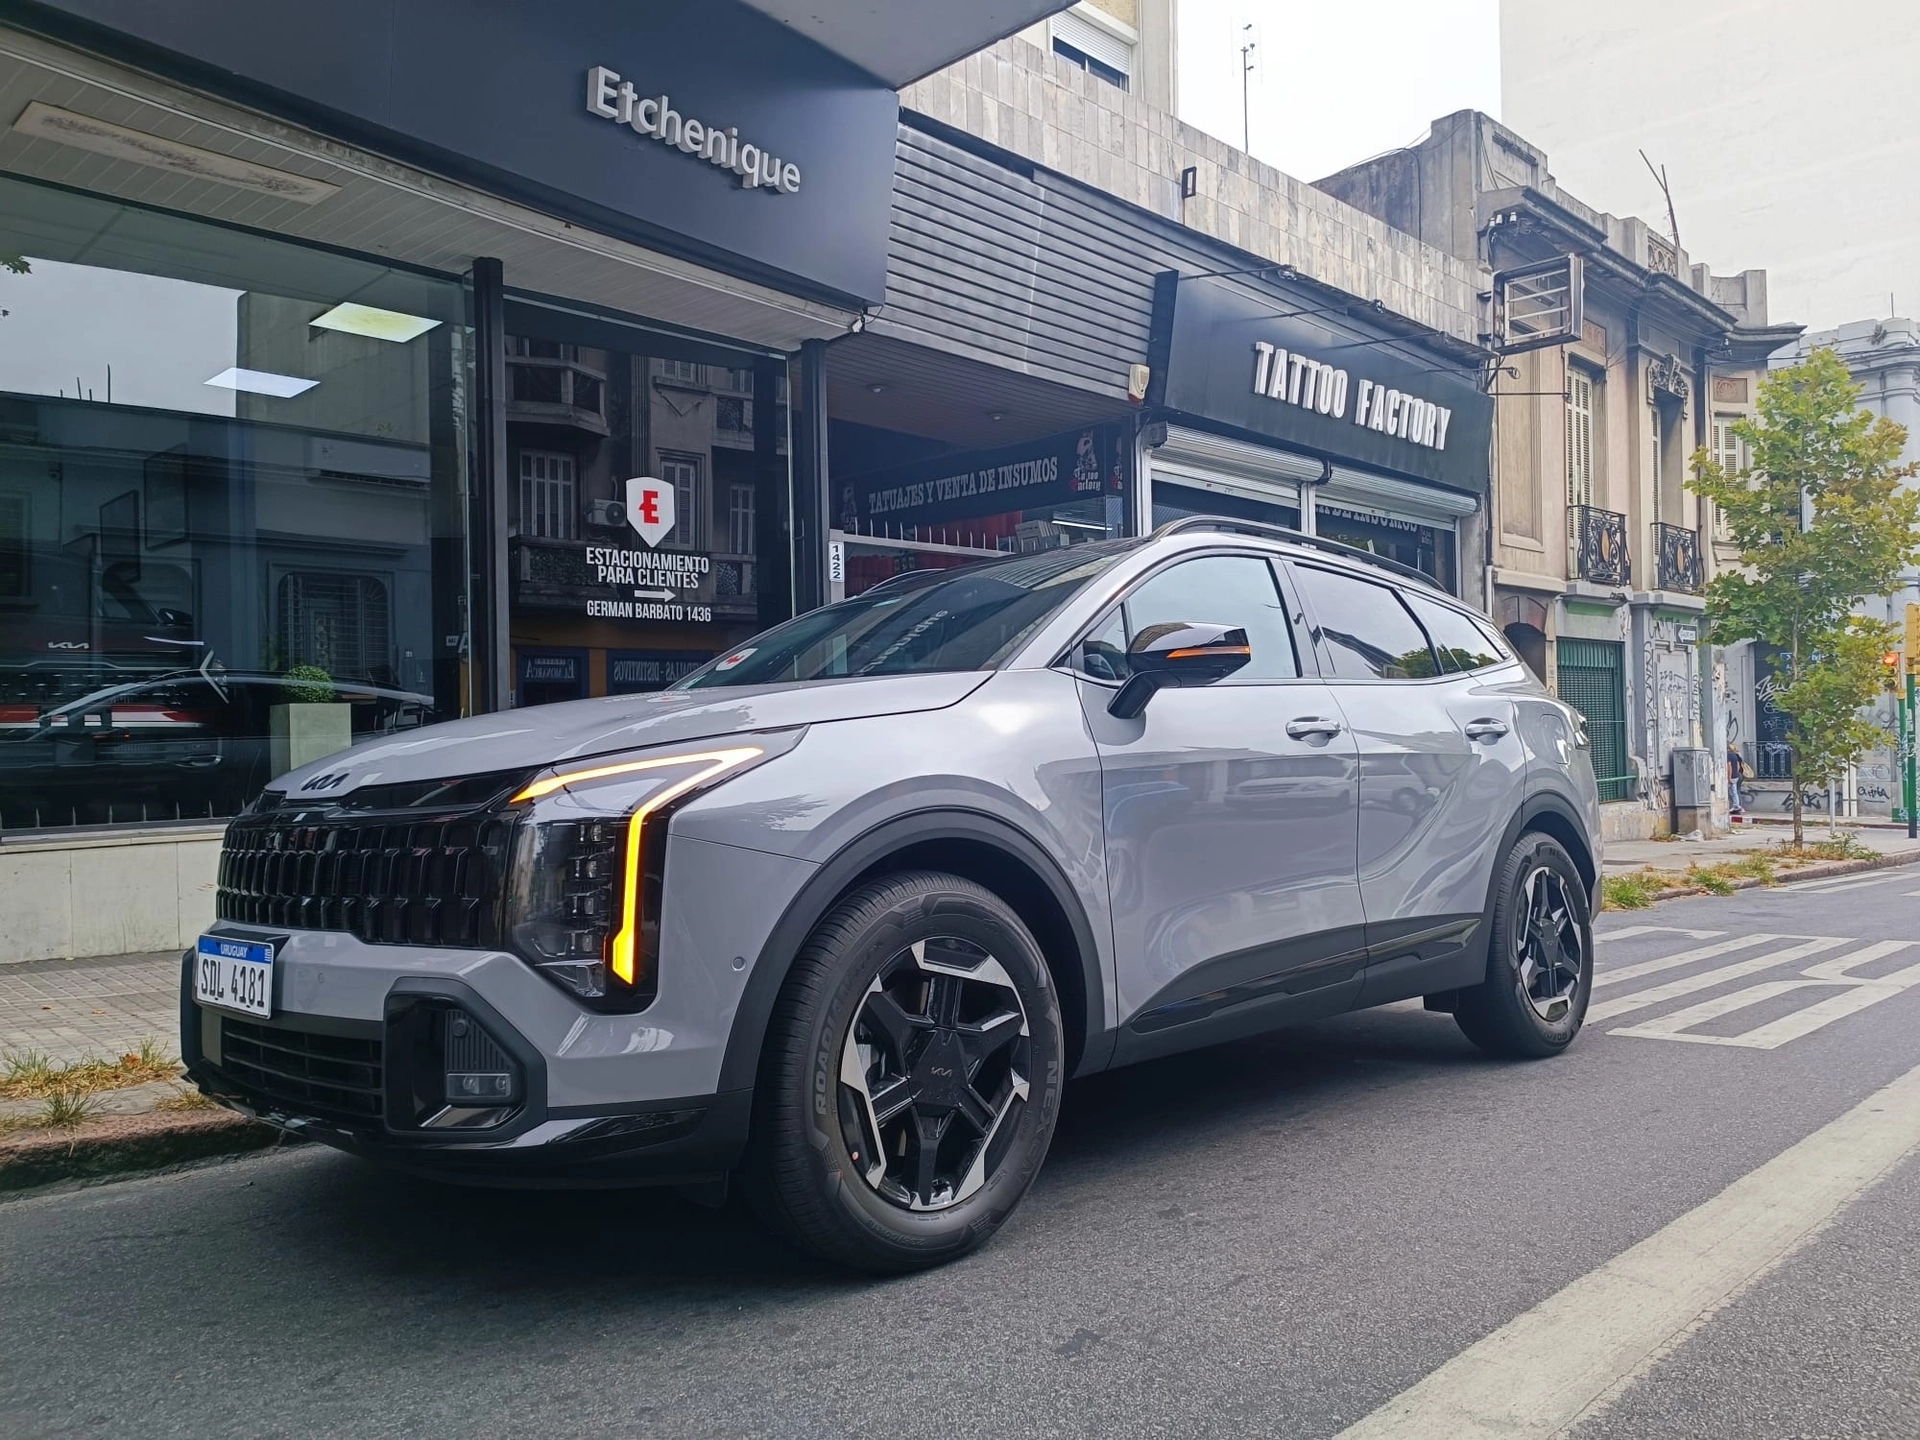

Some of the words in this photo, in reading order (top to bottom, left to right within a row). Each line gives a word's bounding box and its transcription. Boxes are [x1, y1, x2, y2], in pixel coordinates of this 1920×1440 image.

[586, 66, 801, 194] Etchenique
[1254, 341, 1348, 419] TATTOO
[1354, 378, 1452, 452] FACTORY
[868, 482, 925, 515] TATUAJES
[924, 480, 935, 503] Y
[935, 471, 978, 502] VENTA
[979, 468, 996, 495] DE
[997, 456, 1059, 490] INSUMOS
[586, 547, 710, 573] ESTACIONAMIENTO
[597, 565, 635, 585] PARA
[637, 568, 699, 589] CLIENTES
[831, 544, 841, 580] 1422
[587, 600, 633, 618] GERMAN
[635, 602, 683, 621] BARBATO
[686, 605, 712, 623] 1436
[220, 943, 248, 959] URUGUAY
[201, 958, 225, 998] SDL
[231, 964, 265, 1008] 4181
